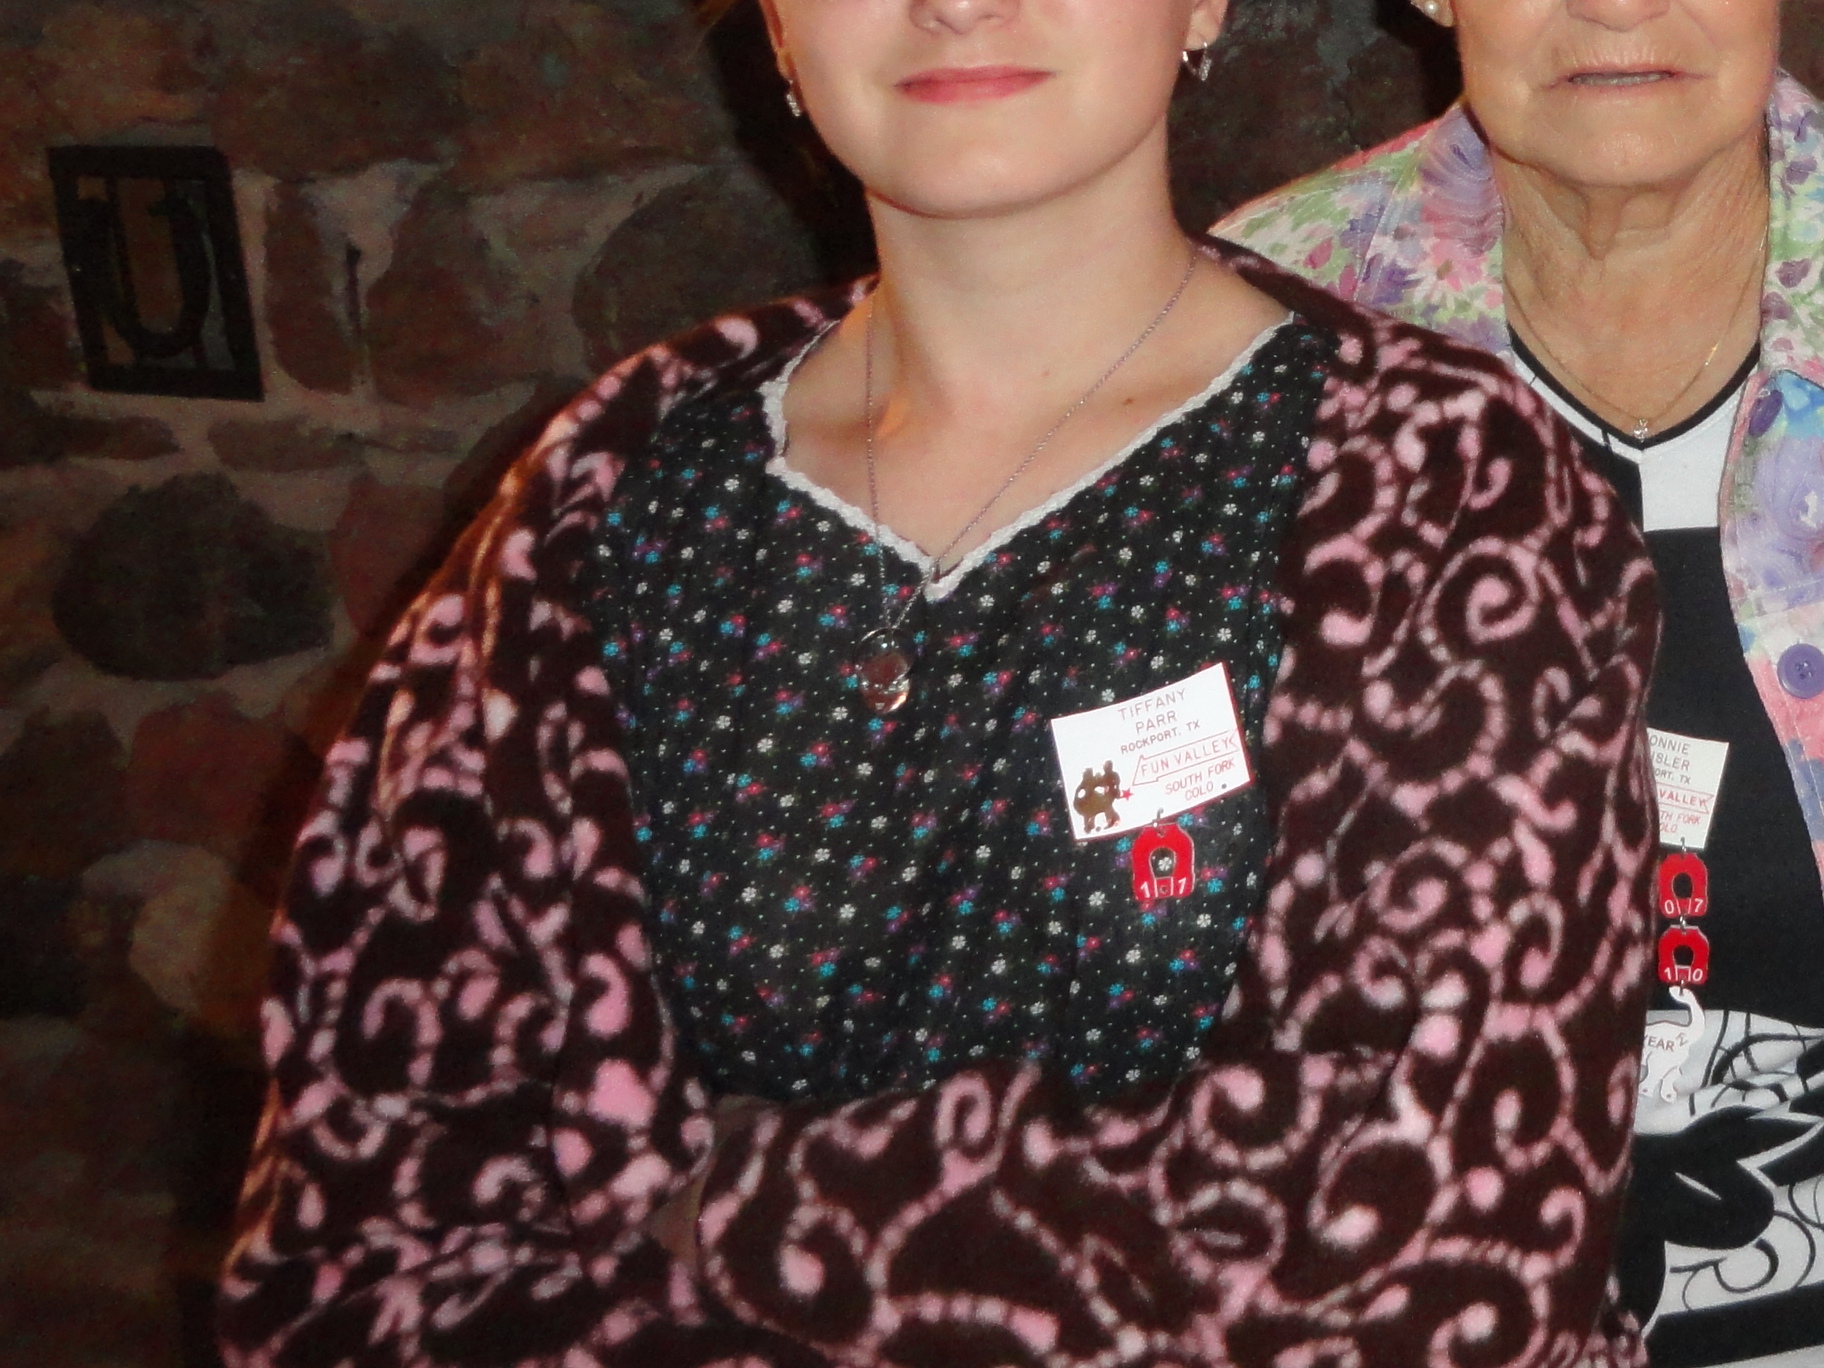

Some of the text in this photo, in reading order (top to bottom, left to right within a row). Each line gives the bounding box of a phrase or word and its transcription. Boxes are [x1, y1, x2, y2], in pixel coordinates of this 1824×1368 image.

[1118, 688, 1186, 720] TIFFANY
[1135, 710, 1177, 734] PARR
[1185, 719, 1201, 731] TX
[1649, 735, 1690, 755] ONNIE
[1140, 736, 1230, 776] FUN VALLEY
[1653, 752, 1690, 771] ISLER
[1164, 758, 1236, 795] SOUTH FORK
[1680, 775, 1691, 784] TX
[1185, 781, 1214, 802] COLO
[1659, 789, 1706, 807] VALLEY
[1677, 813, 1701, 825] FORK
